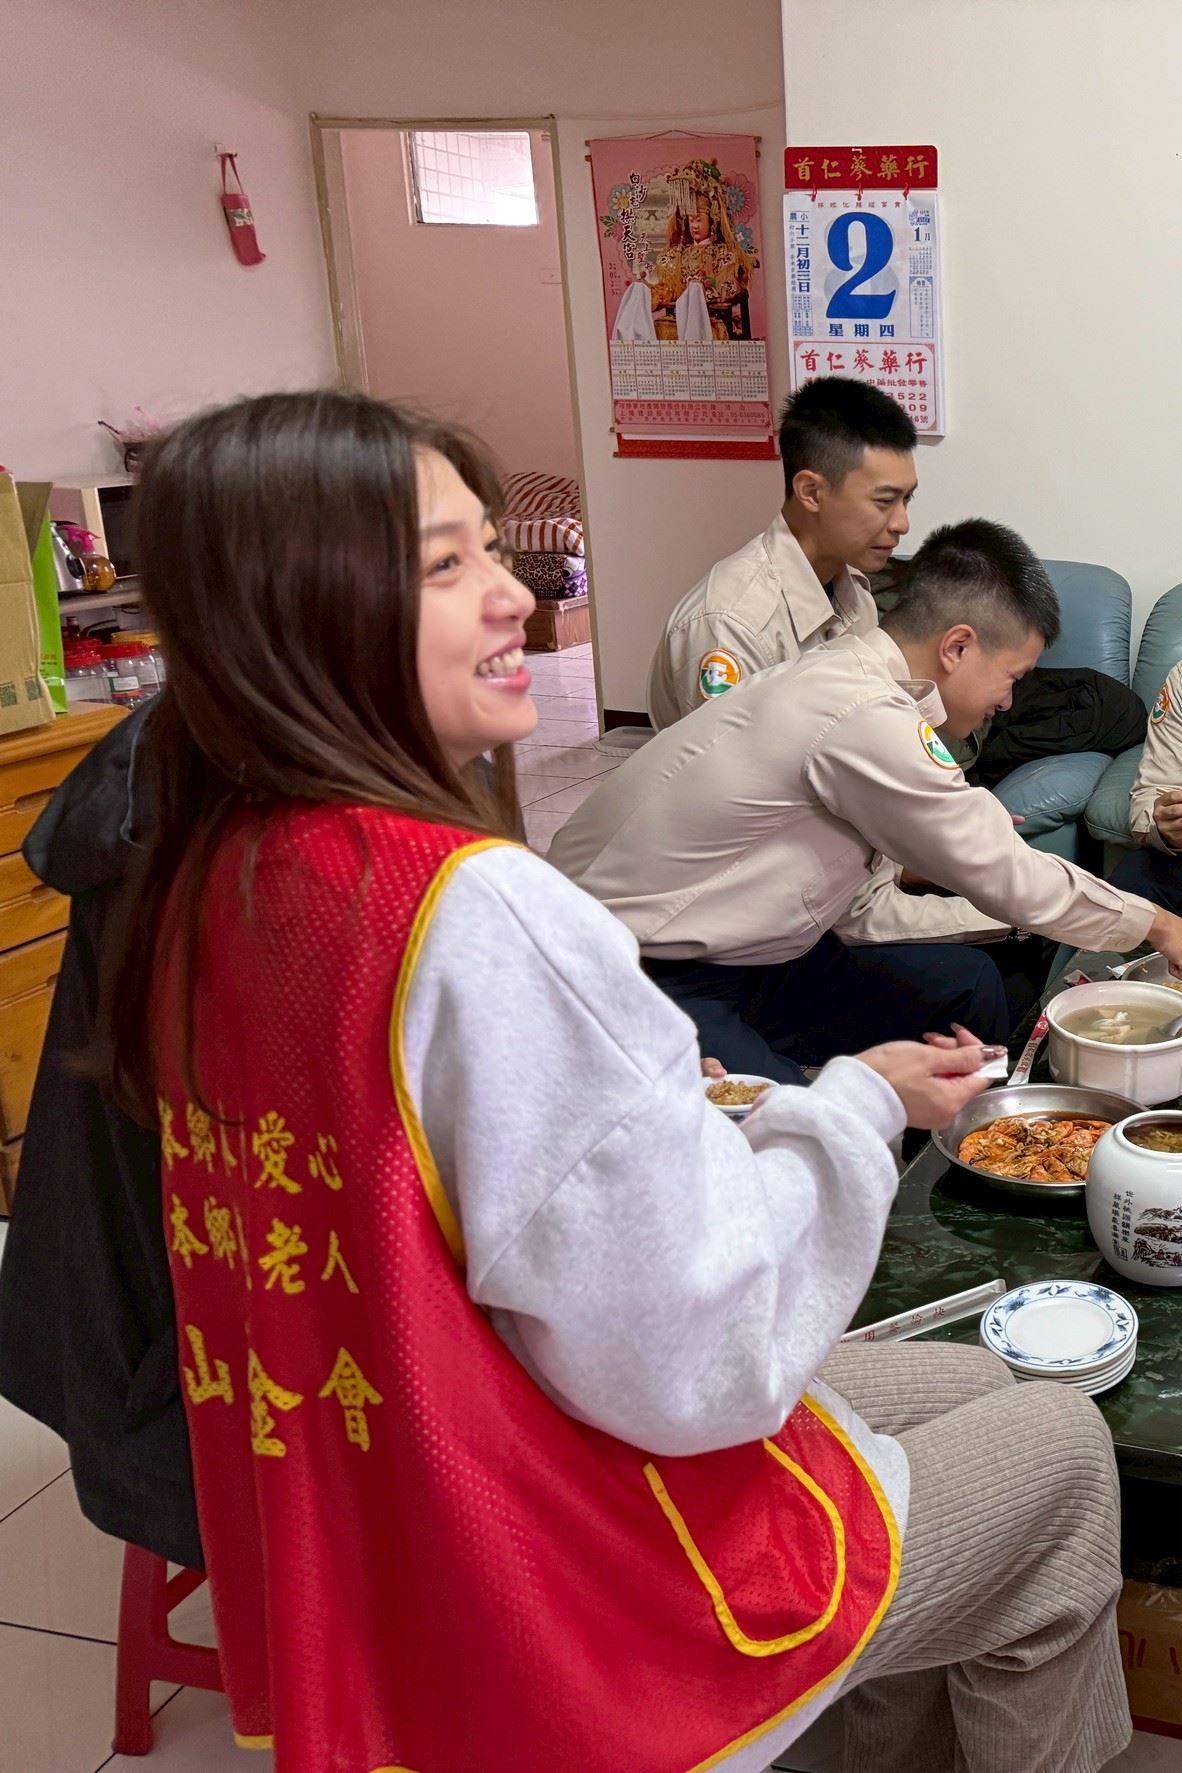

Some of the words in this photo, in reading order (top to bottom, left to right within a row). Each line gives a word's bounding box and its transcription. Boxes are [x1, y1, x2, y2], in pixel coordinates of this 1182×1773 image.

[796, 224, 811, 293] 十二月初三日
[826, 212, 897, 320] 2
[828, 323, 896, 337] 星期四
